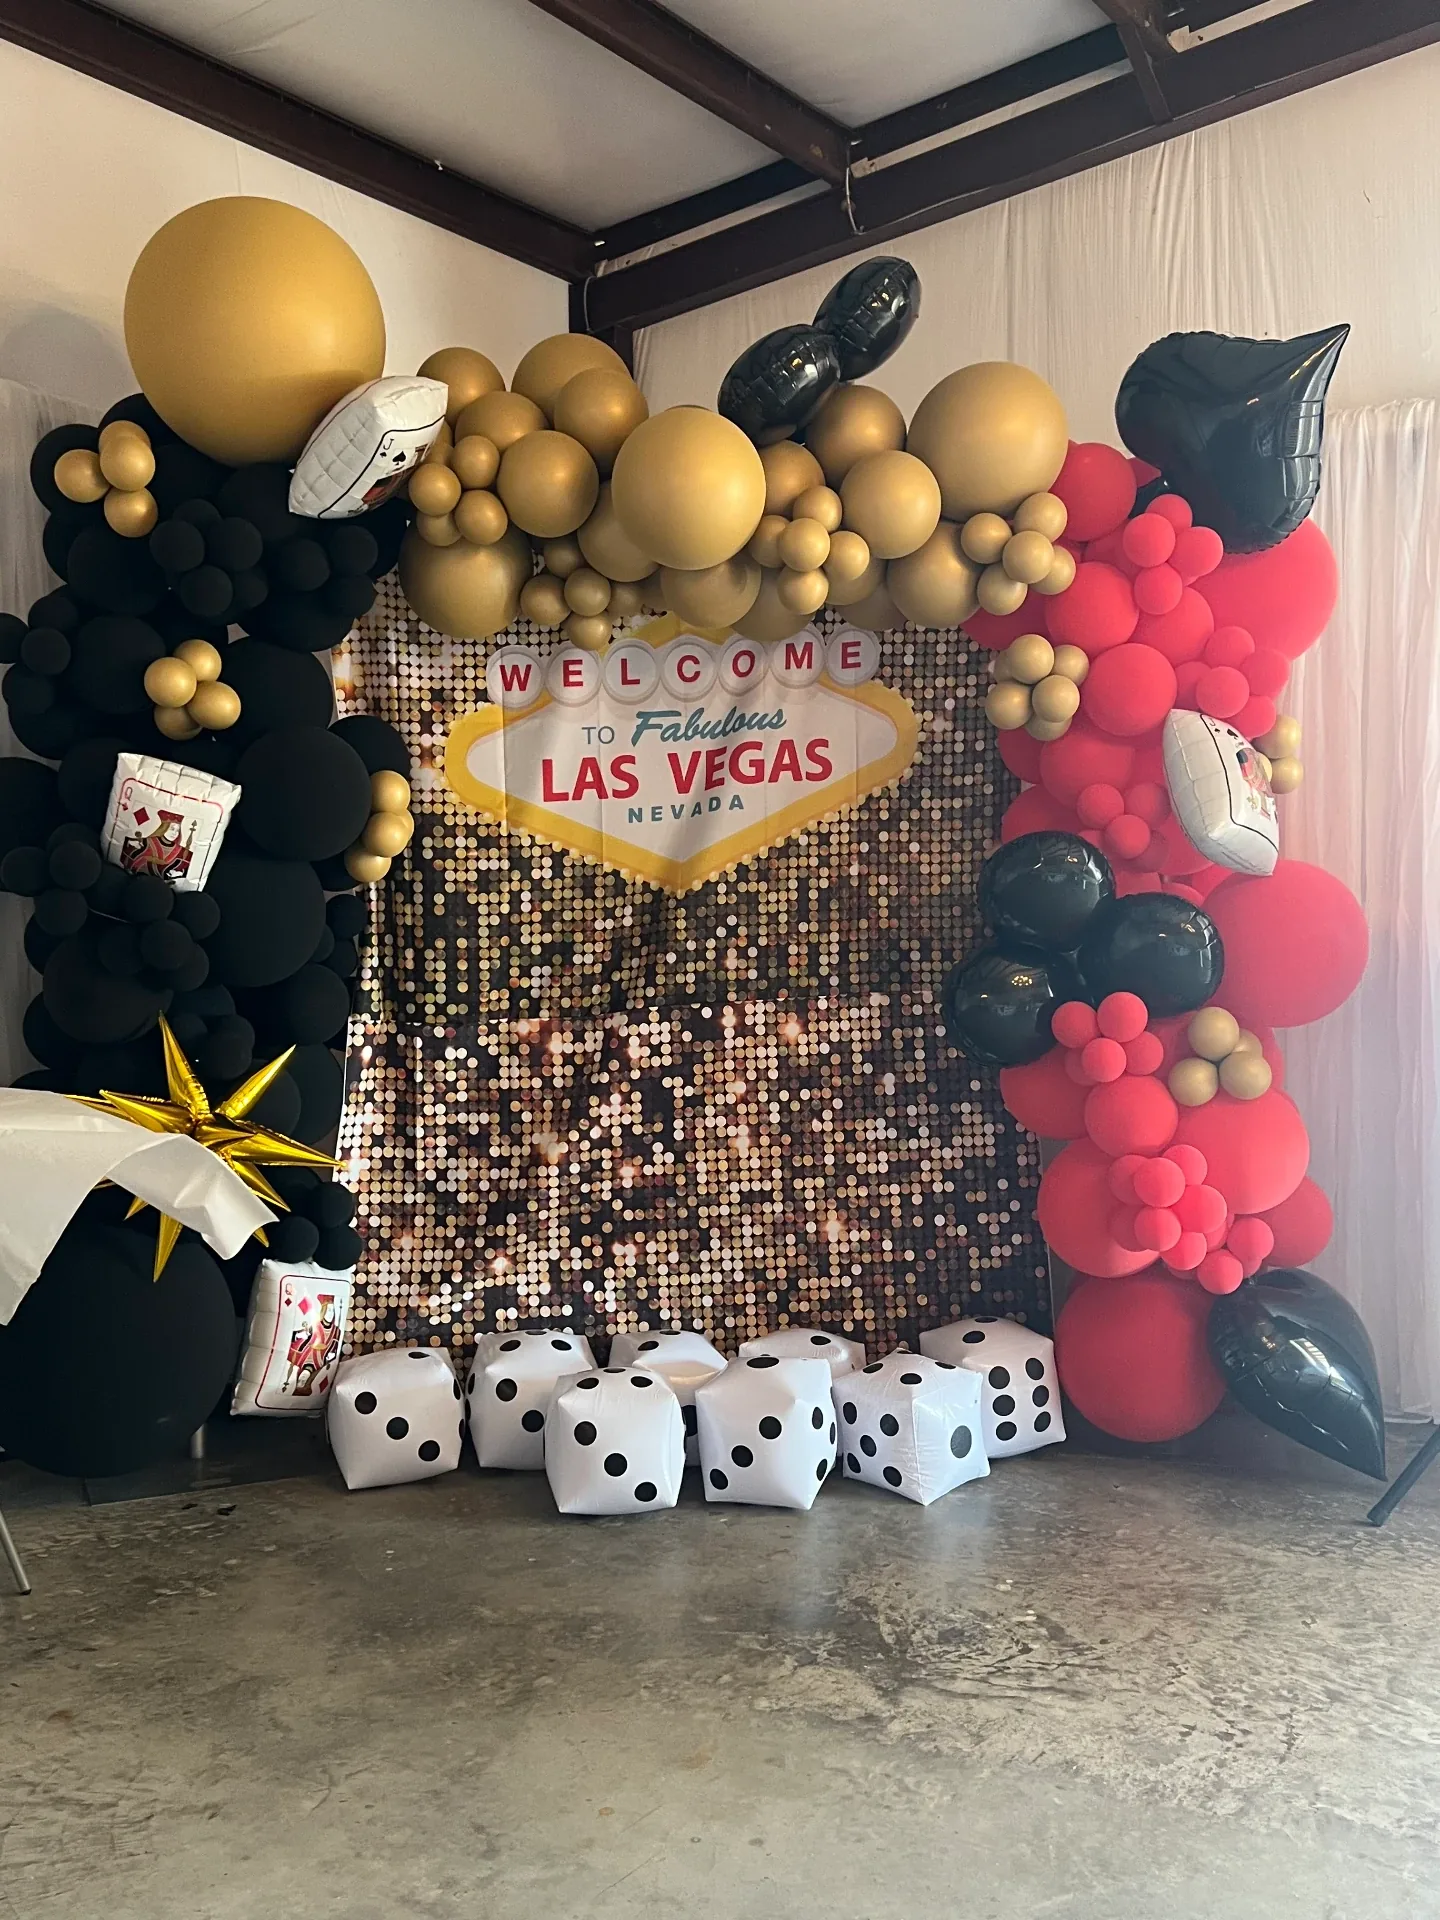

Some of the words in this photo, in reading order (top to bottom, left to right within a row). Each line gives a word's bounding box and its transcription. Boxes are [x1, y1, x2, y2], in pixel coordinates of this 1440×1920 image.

[383, 438, 395, 450] J
[499, 640, 862, 693] WELCOME
[581, 726, 615, 745] TO
[630, 705, 787, 747] Fabulous
[541, 754, 640, 803] LAS
[667, 738, 833, 795] VEGAS
[627, 794, 745, 824] NEVADA
